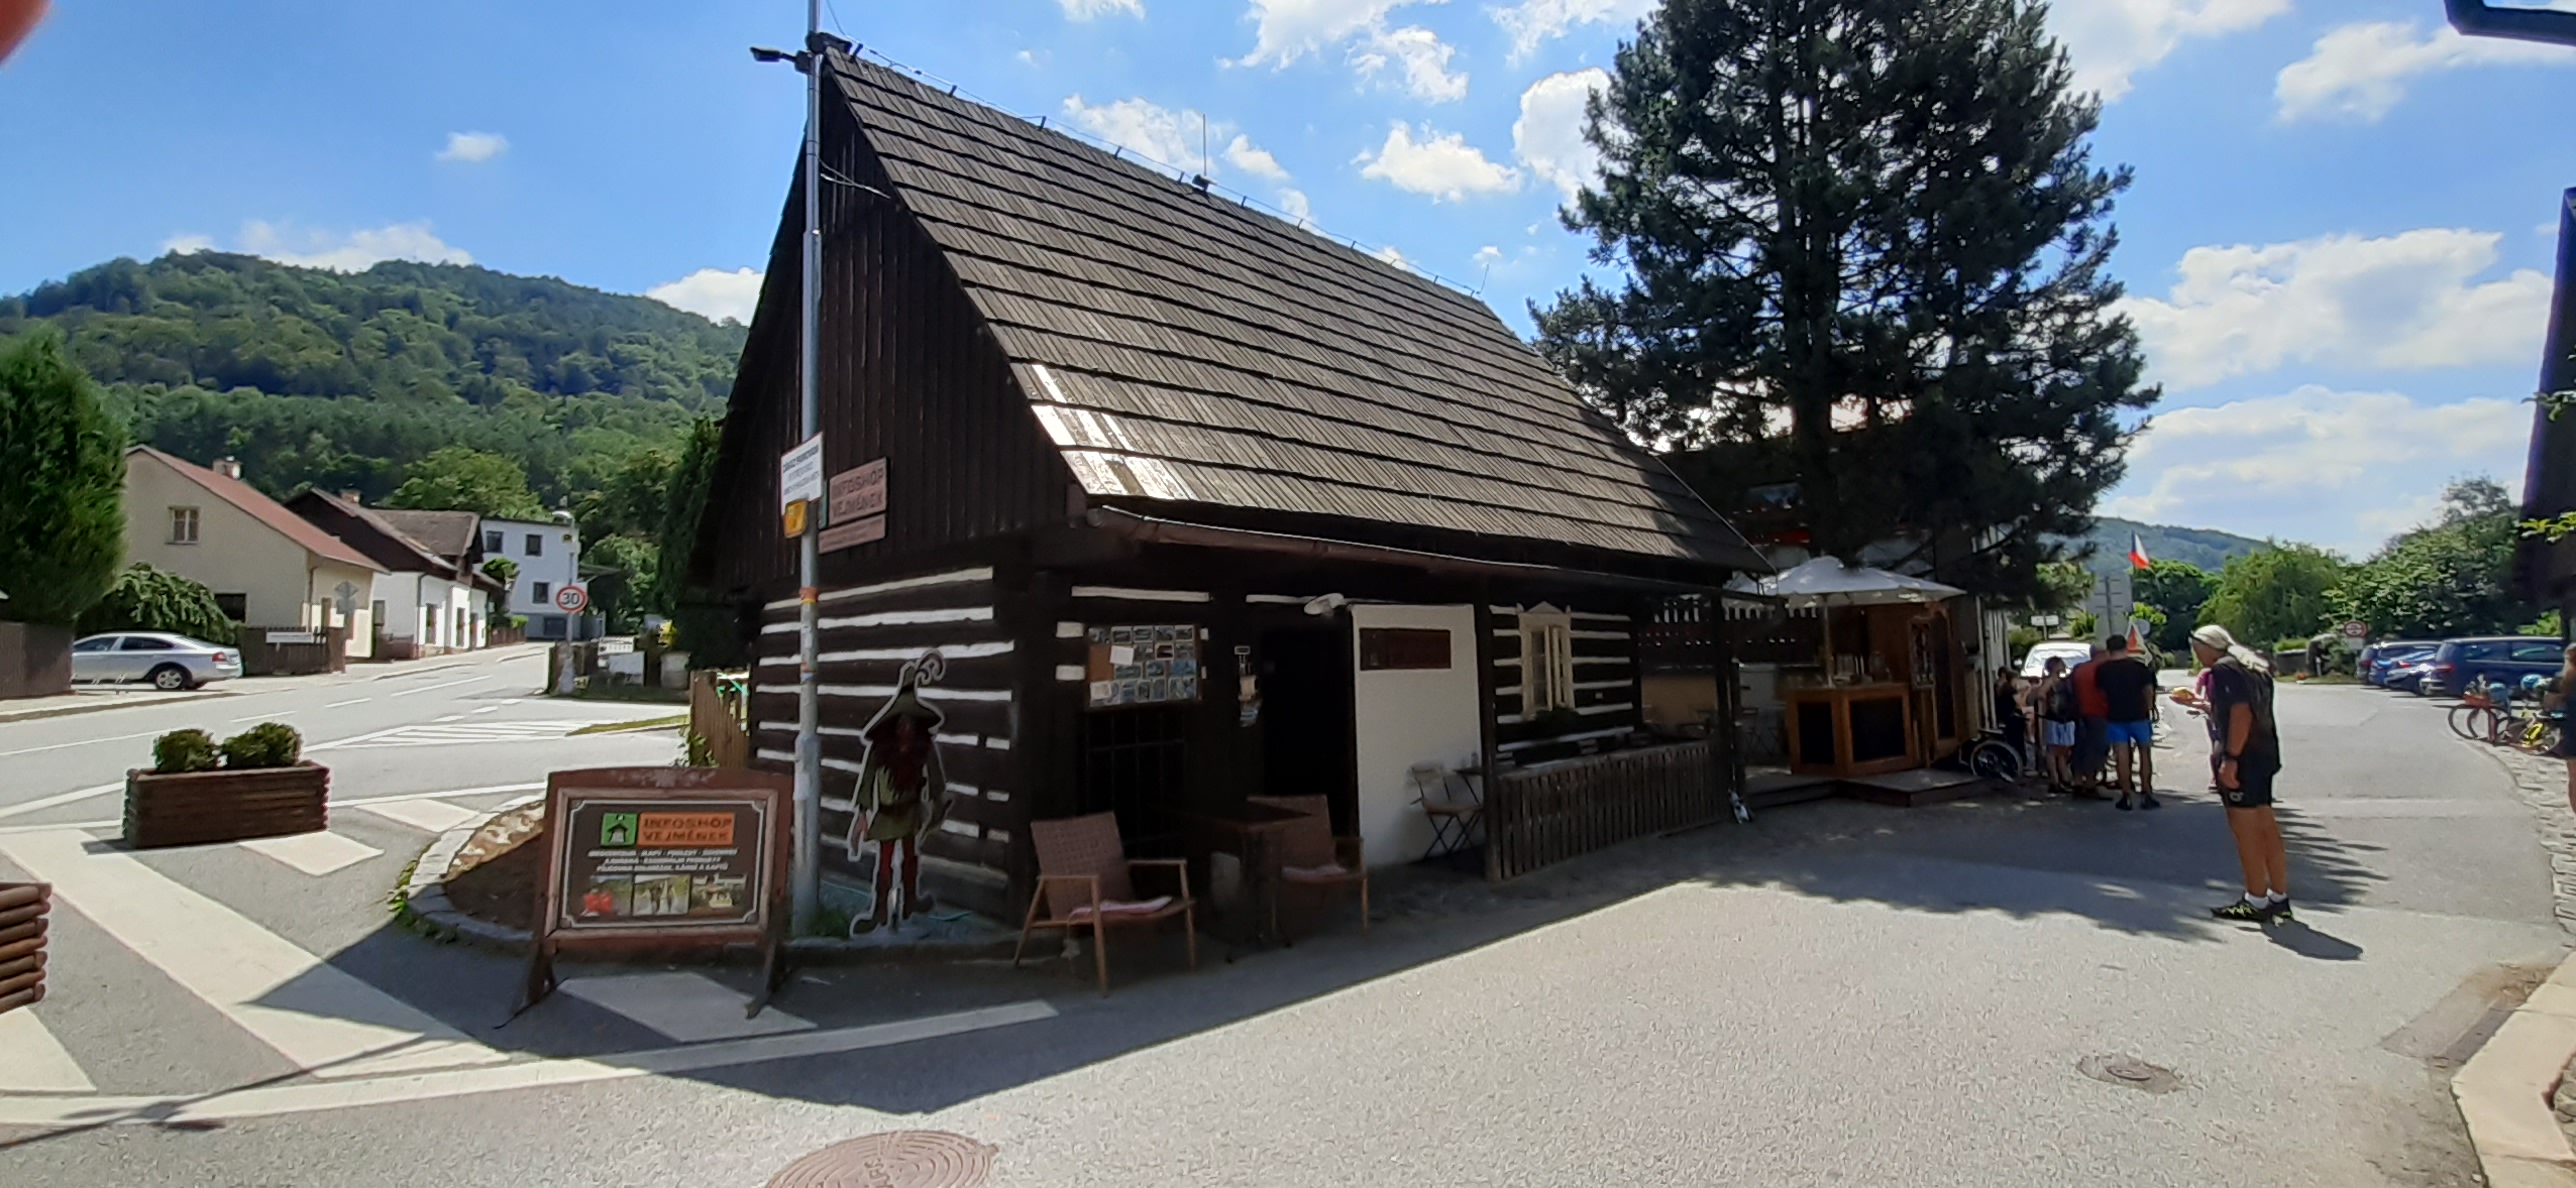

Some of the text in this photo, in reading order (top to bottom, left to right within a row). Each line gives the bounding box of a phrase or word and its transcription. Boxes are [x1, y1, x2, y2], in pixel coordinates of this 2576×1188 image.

[562, 592, 580, 605] 30
[644, 817, 732, 829] INFOSHOP
[643, 829, 728, 841] VEJMÉNEK
